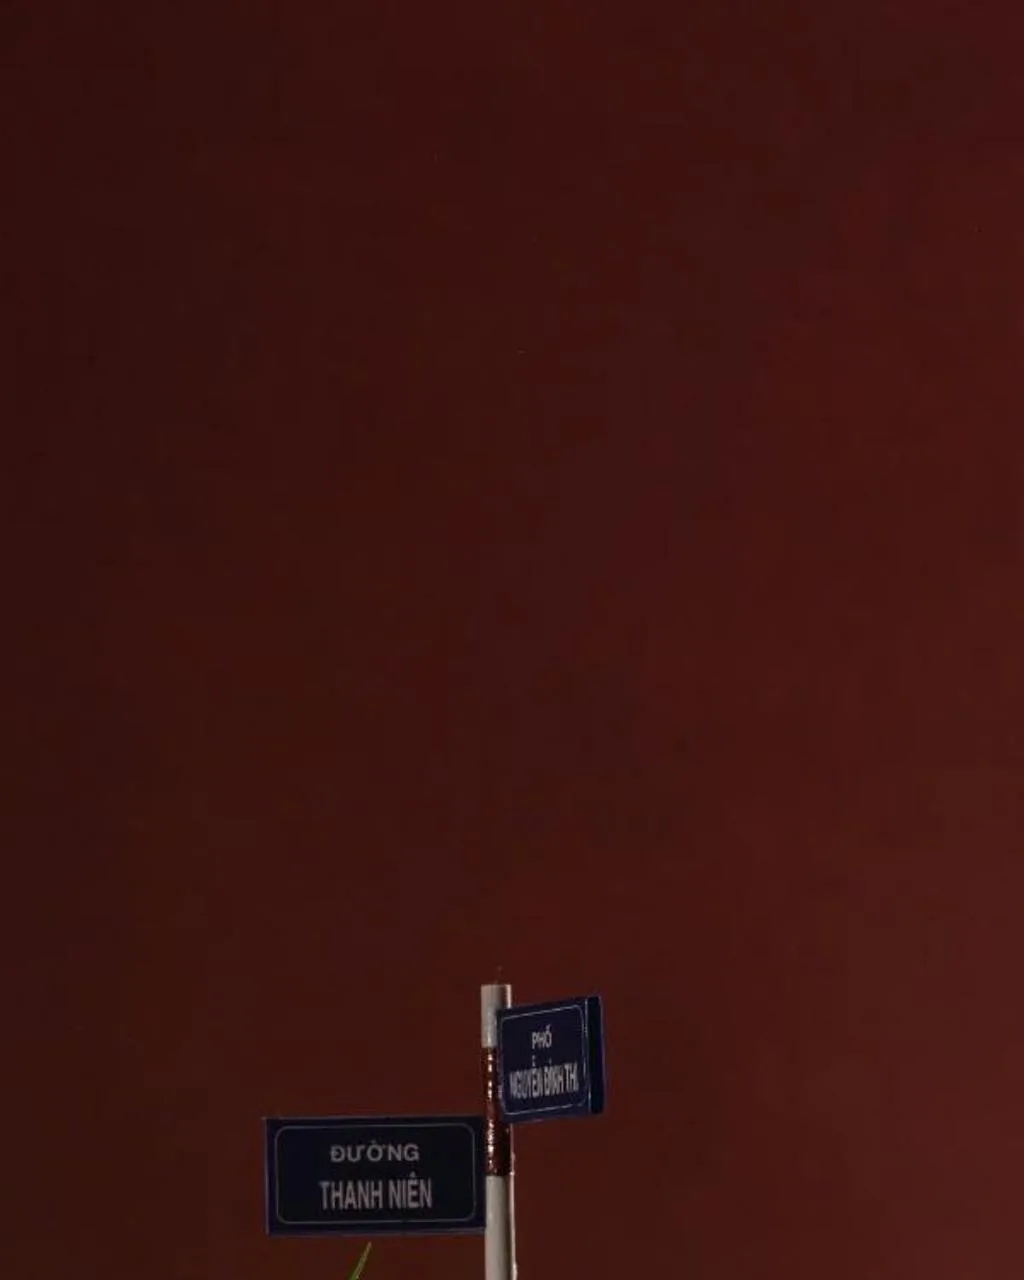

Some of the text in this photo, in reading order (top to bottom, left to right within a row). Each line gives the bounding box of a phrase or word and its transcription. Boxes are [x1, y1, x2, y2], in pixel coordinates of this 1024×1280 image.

[531, 1024, 553, 1049] PHỐ
[330, 1140, 420, 1163] ĐƯỜNG
[319, 1171, 433, 1210] THANH NIÊN
